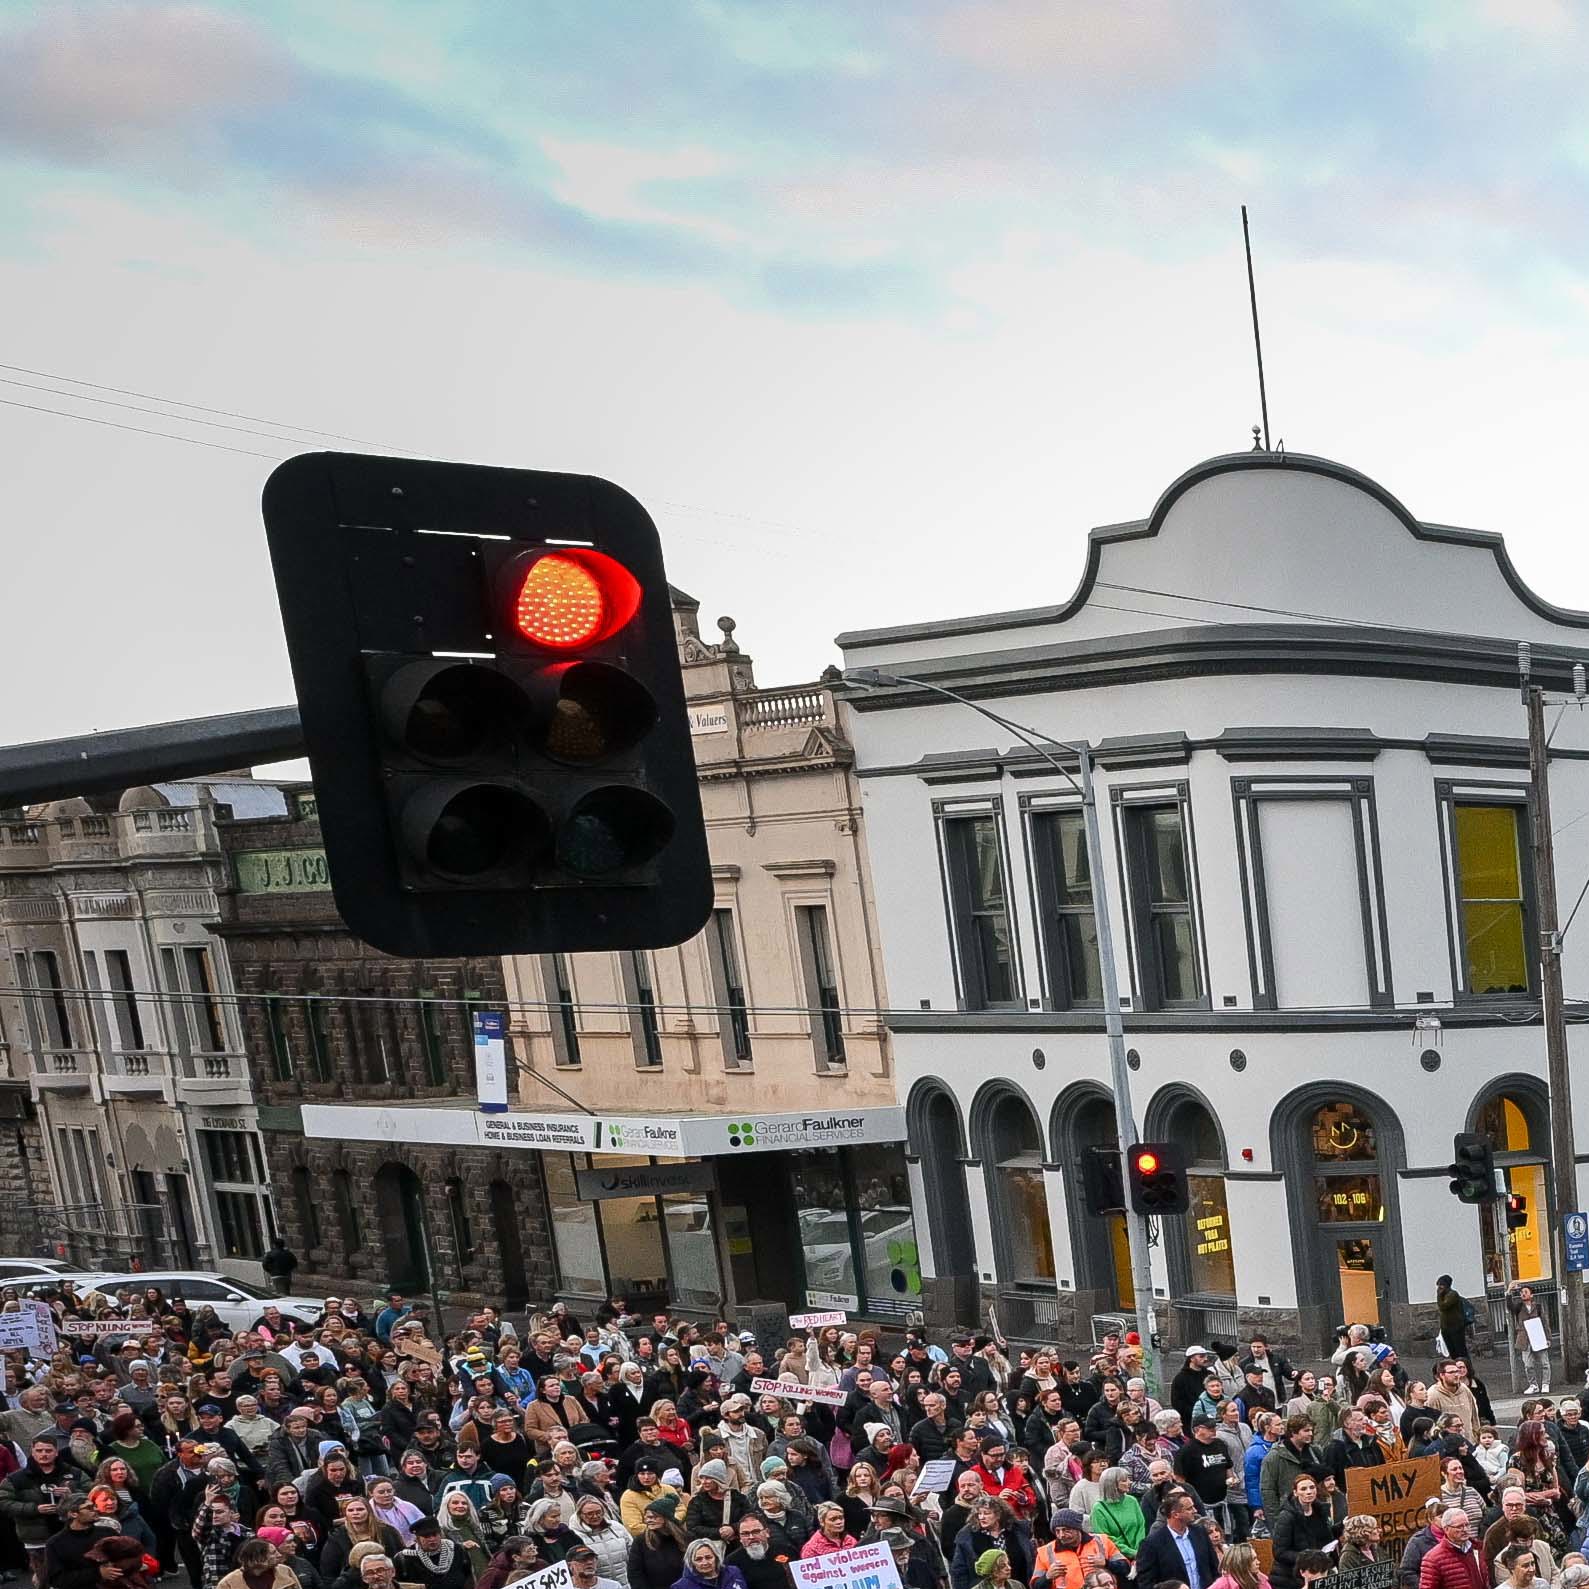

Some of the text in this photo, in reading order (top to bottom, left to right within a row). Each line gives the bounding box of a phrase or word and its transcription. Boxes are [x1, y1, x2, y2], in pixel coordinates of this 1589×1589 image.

[486, 1120, 511, 1130] GENERAL
[517, 1122, 546, 1132] BUSINESS
[546, 1124, 579, 1134] INSURANCE
[756, 1128, 865, 1145] FINANCIAL SERVICES
[484, 1132, 500, 1140] HOME
[507, 1133, 535, 1142] BUSINESS
[535, 1135, 551, 1143] LOAN
[67, 1322, 94, 1332] STOP
[95, 1321, 131, 1332] KILLING
[753, 1380, 844, 1399] STOP KILLING WOMEN
[1370, 1469, 1417, 1506] MAY
[800, 1547, 880, 1573] end violence
[801, 1558, 889, 1584] against women
[1314, 1580, 1324, 1589] IF
[1324, 1574, 1338, 1587] YOU
[1338, 1569, 1360, 1583] THINK
